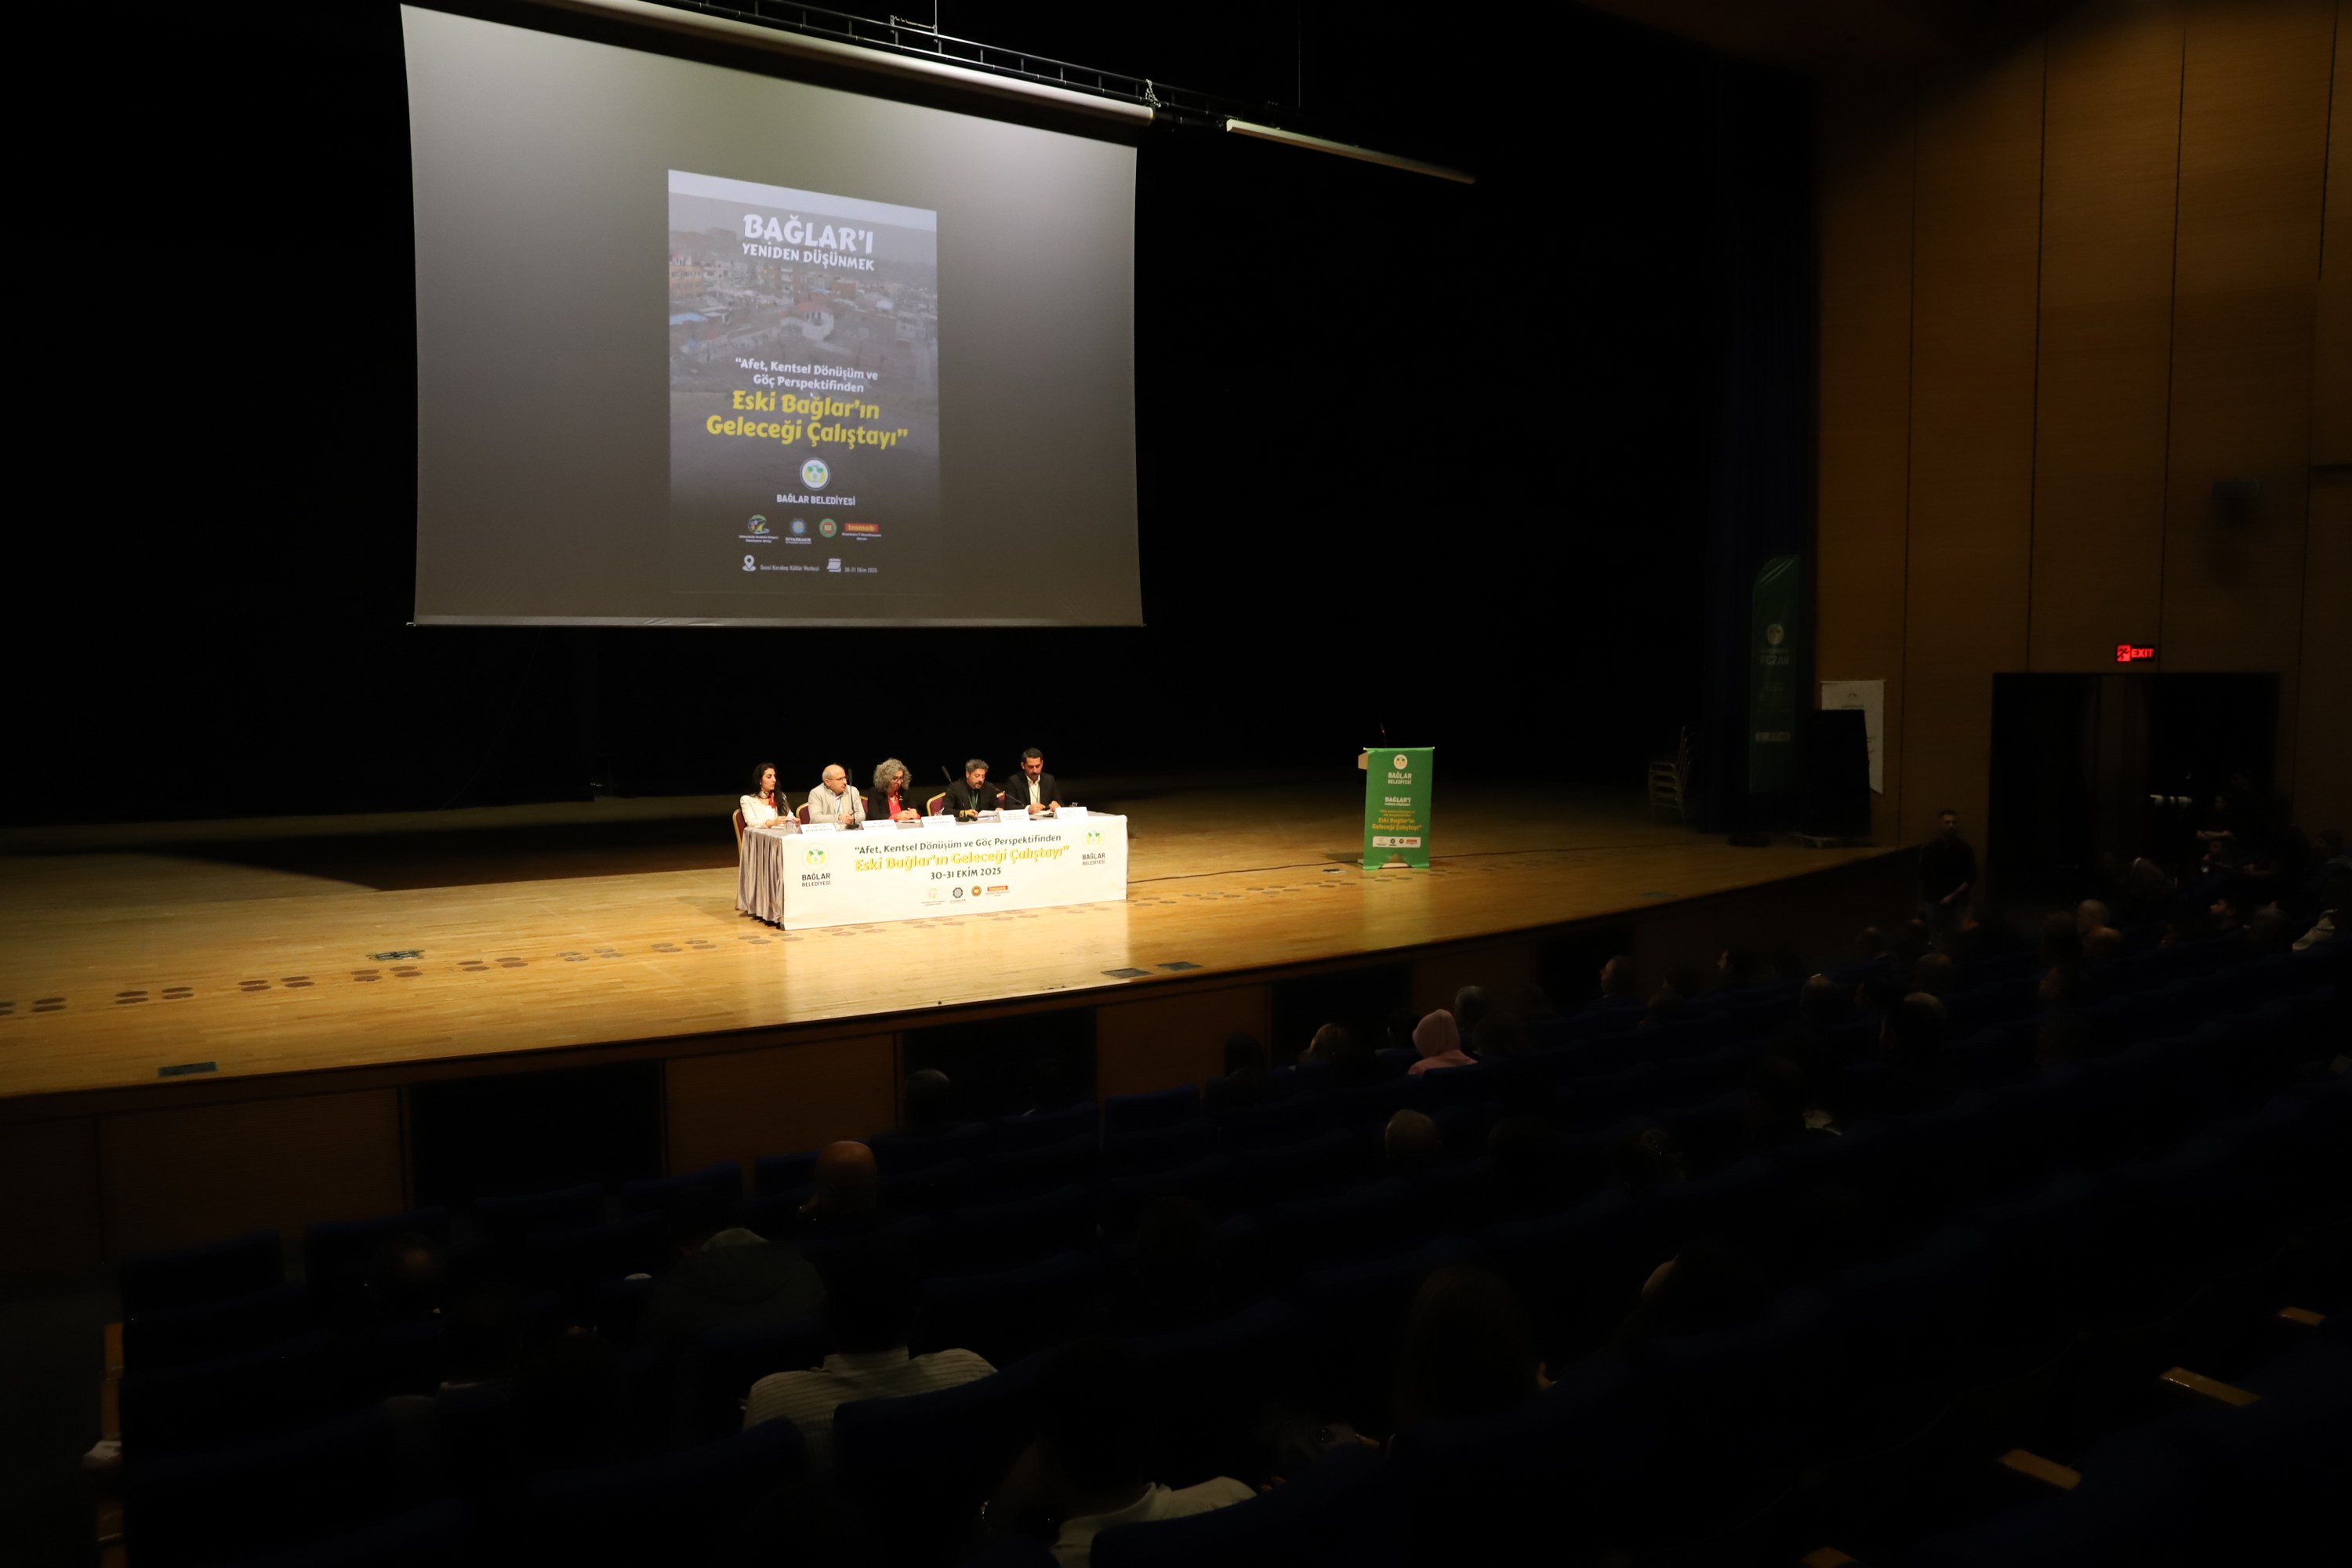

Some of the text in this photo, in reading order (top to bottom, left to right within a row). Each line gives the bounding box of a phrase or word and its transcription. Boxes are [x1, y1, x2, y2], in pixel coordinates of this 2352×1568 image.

[742, 214, 873, 254] BAĞLAR’I
[742, 241, 875, 271] YENİDEN DÜŞÜNMEK
[771, 361, 811, 374] Kentsel
[814, 364, 864, 380] Dönüşüm
[866, 371, 878, 380] ve
[753, 375, 864, 393] Göç Perspektifinden
[732, 390, 775, 412] Eski
[706, 416, 908, 450] Geleceği Çalıştayı”
[776, 493, 856, 506] BAĞLAR BELEDİYESİ
[2131, 648, 2154, 658] EXIT
[884, 843, 917, 852] Kentsel
[920, 840, 962, 851] Dönüşüm
[975, 838, 992, 848] Göç
[994, 834, 1062, 846] Perspektifinden
[855, 857, 882, 871] Eski
[951, 848, 1007, 865] Geleceği
[931, 866, 1001, 880] 30-31 EKİM 2025
